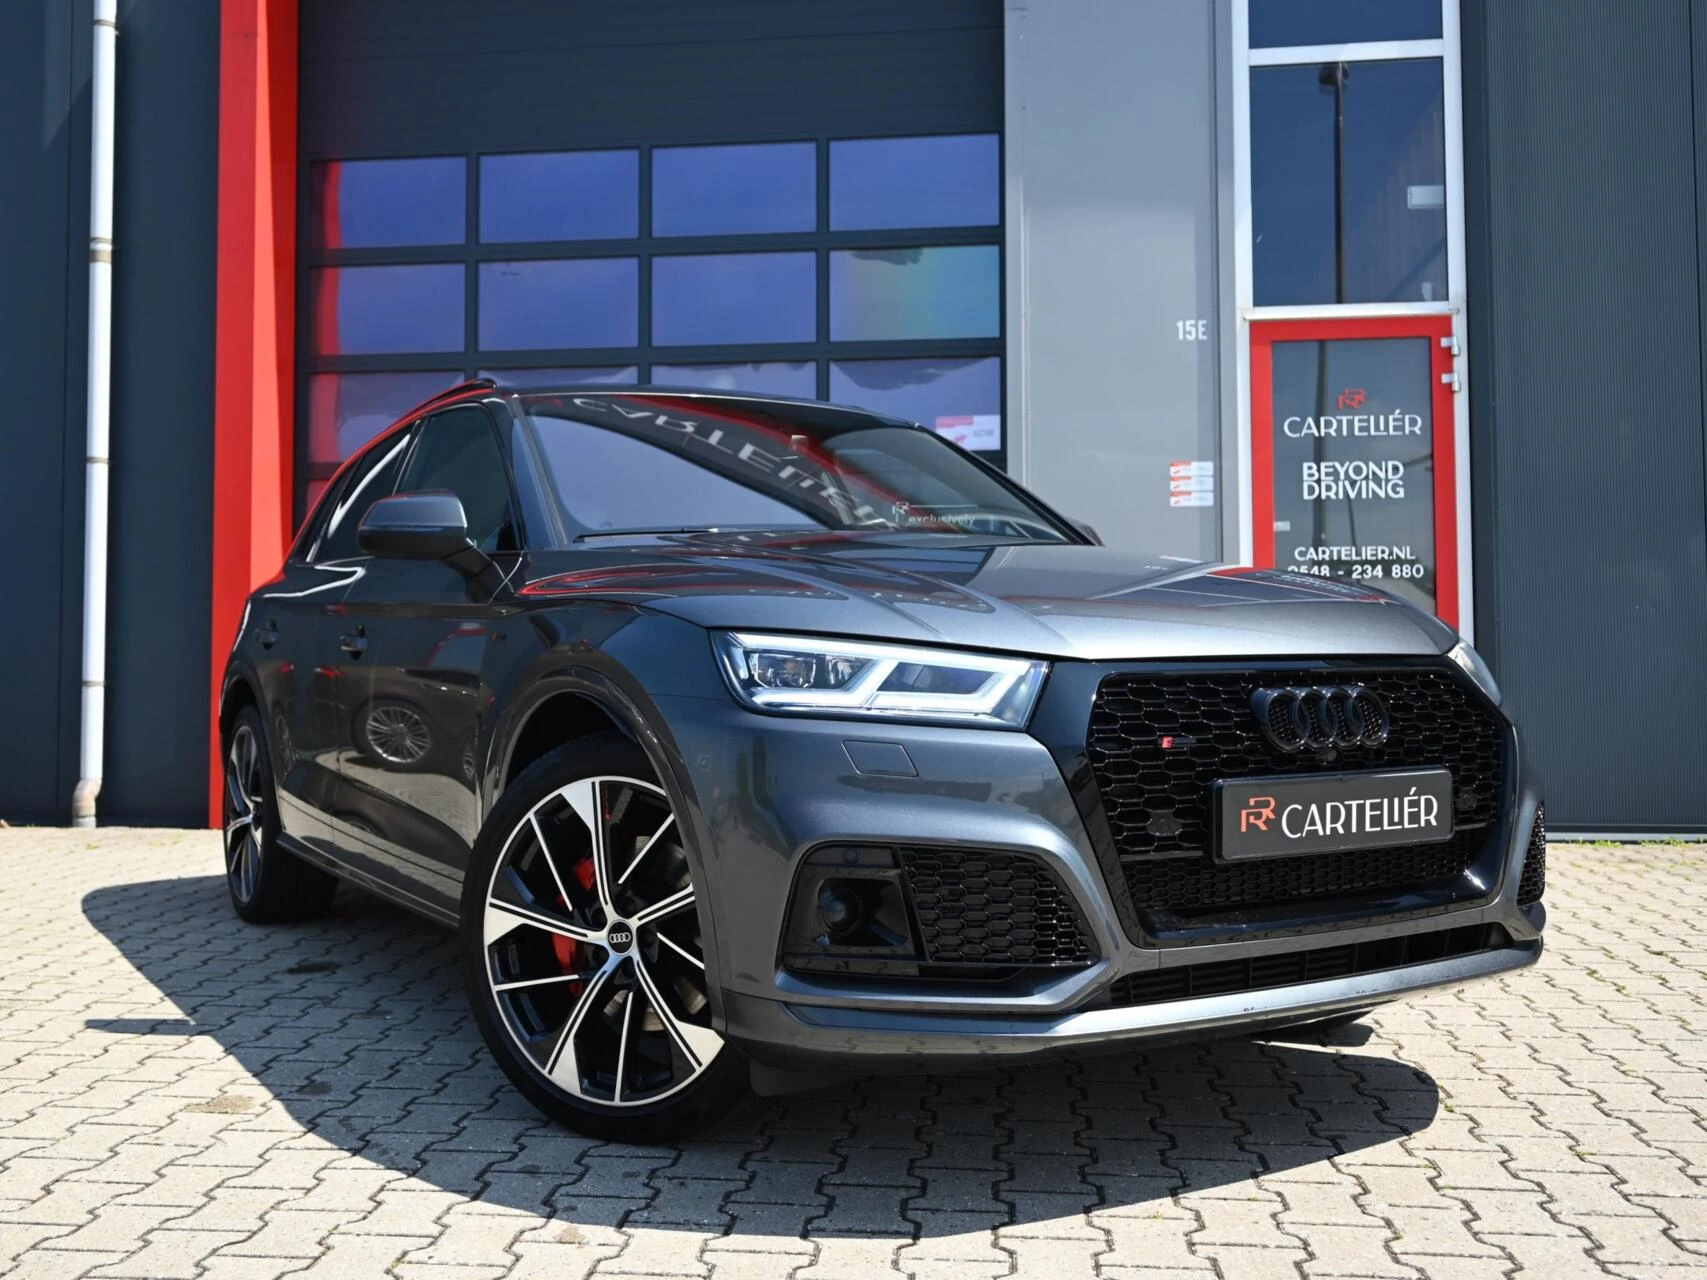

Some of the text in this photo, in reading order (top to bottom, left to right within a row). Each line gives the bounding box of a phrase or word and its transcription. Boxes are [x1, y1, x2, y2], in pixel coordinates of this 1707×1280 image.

[1176, 319, 1208, 341] 15E
[1302, 460, 1404, 482] BEYOND
[1303, 479, 1405, 500] DRIVING
[907, 513, 976, 528] exclusively
[1294, 545, 1417, 561] CARTELIER.NL
[1351, 564, 1383, 579] 234
[1391, 563, 1424, 578] 880
[1281, 786, 1438, 839] CARTELIÉR
